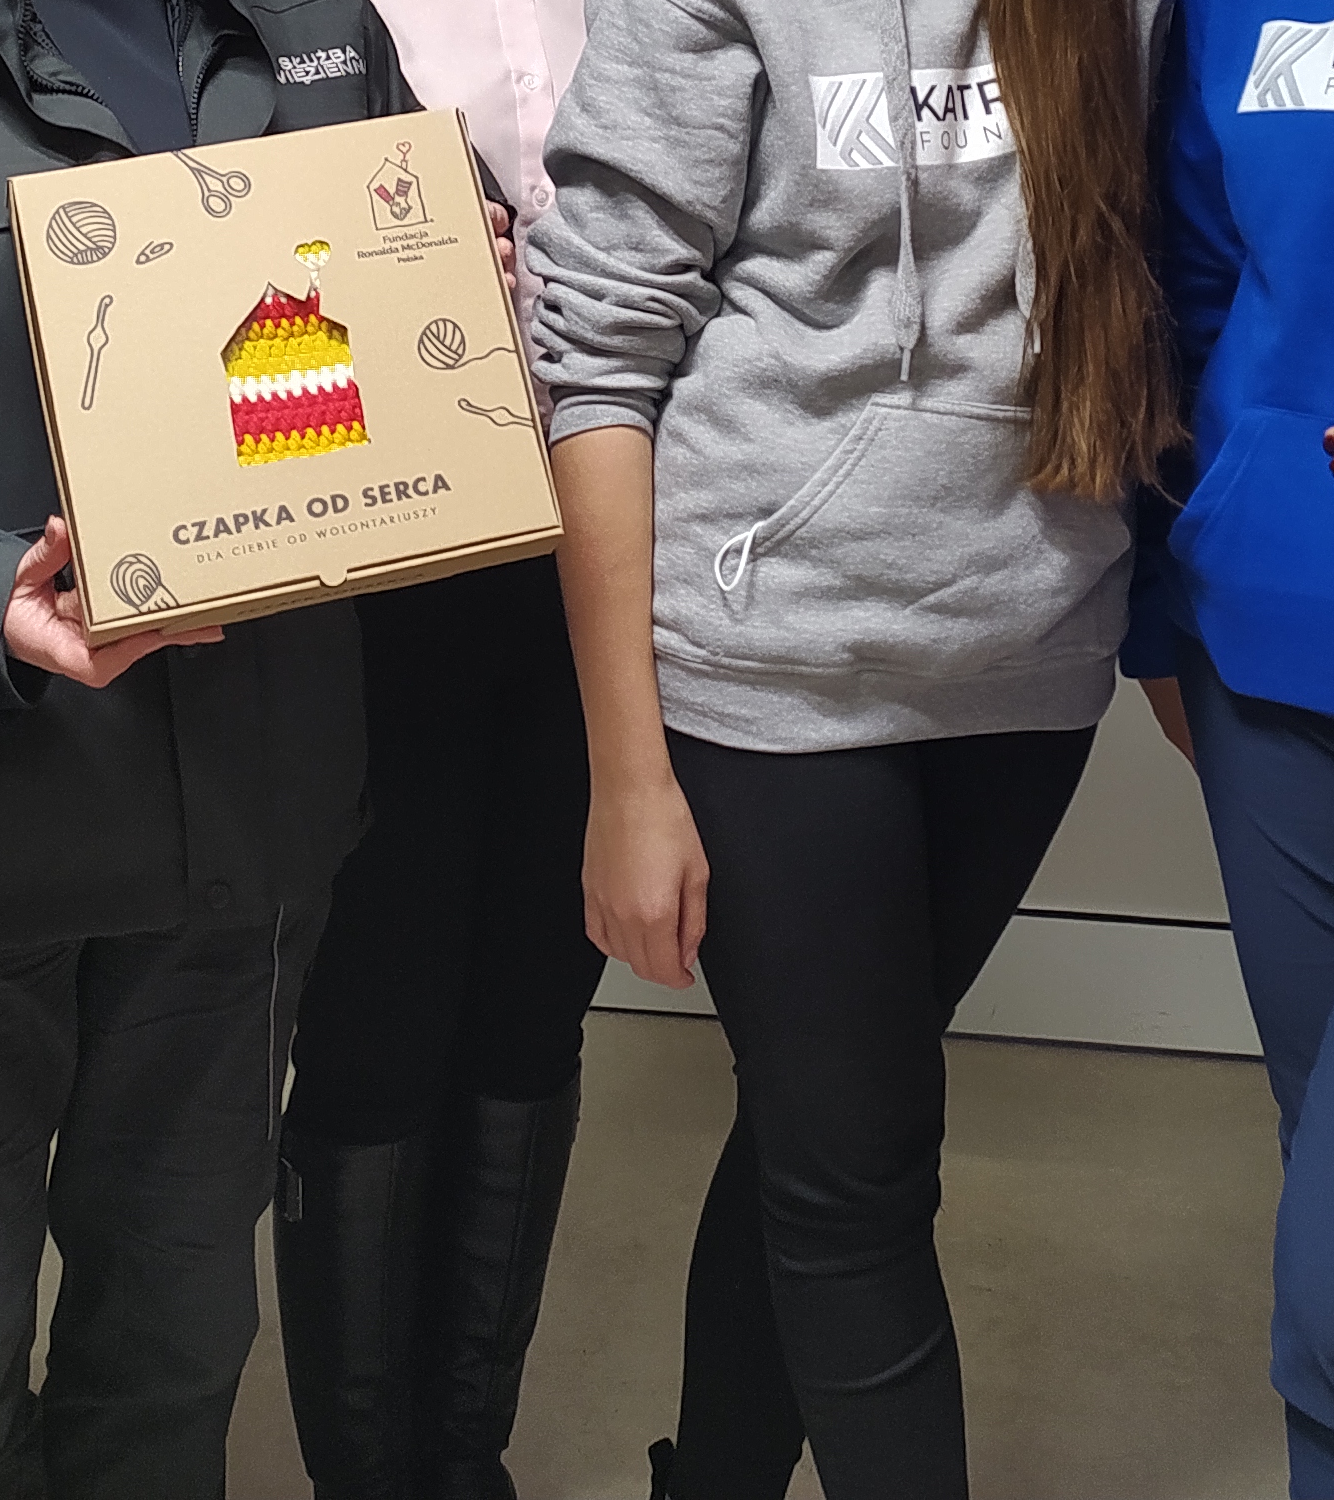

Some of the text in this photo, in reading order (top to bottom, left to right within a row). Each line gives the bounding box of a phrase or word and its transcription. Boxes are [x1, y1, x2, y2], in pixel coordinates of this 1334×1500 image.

[278, 45, 360, 70] SŁUŻBA
[357, 236, 459, 259] Ronalda McDonalda
[382, 230, 429, 244] Fundacja
[172, 473, 451, 546] CZAPKA OD SERCA
[197, 506, 439, 564] DLA CIEBIE OD WOLONTARIUSZY
